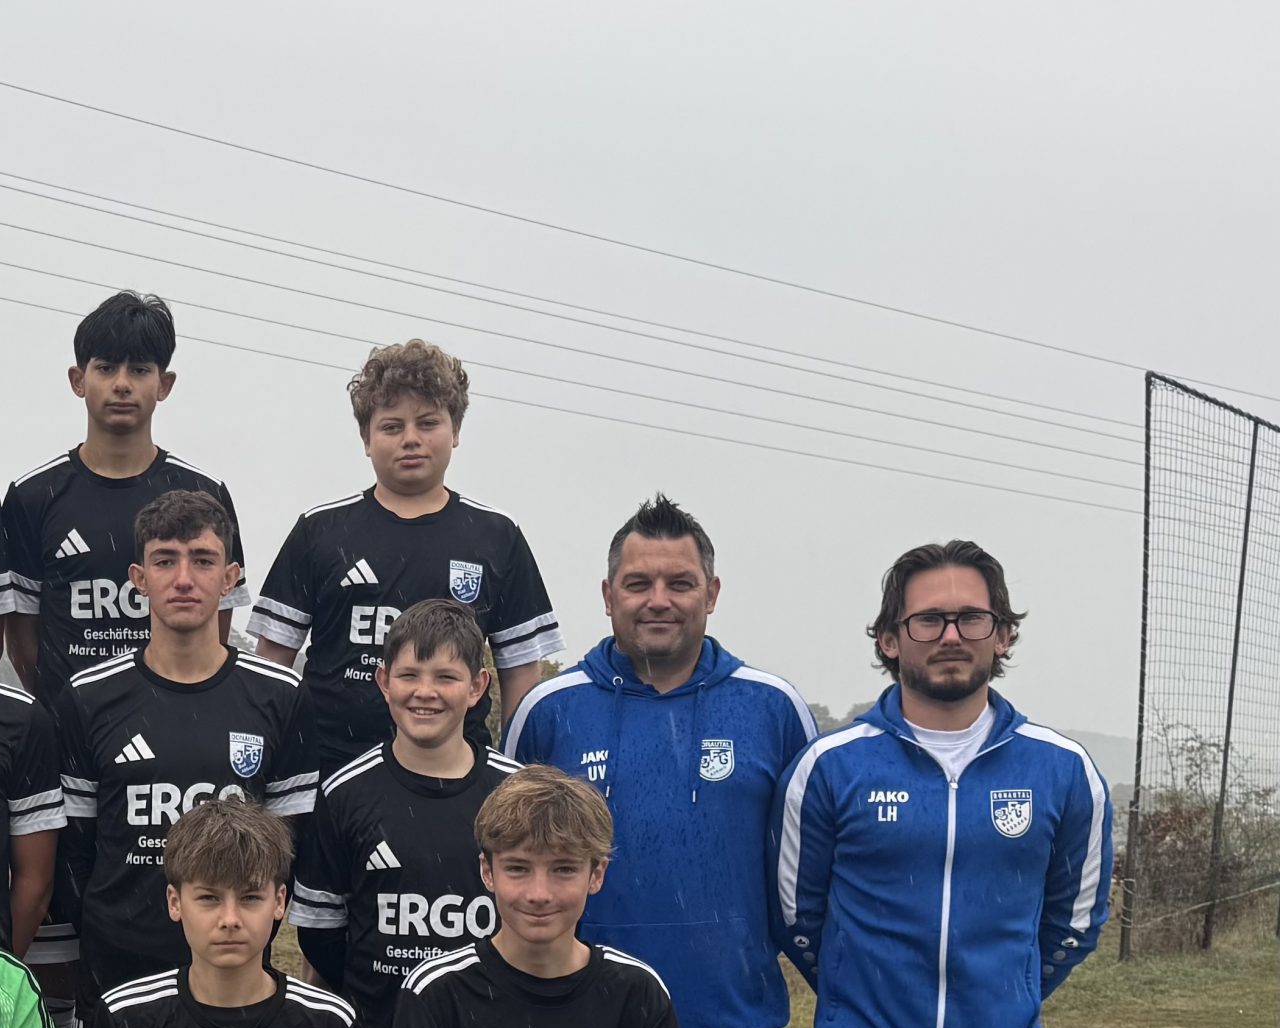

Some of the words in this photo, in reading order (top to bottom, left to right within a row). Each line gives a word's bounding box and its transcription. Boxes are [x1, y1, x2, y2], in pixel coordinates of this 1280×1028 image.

[70, 579, 150, 619] ERG
[350, 605, 402, 645] ER
[83, 628, 151, 640] Geschäftsst
[68, 644, 96, 656] Marc
[100, 647, 109, 656] u.
[344, 667, 372, 681] Marc
[580, 750, 609, 765] JAK
[587, 764, 607, 781] UV
[867, 791, 910, 803] JAKO
[877, 806, 898, 822] LH
[377, 893, 496, 939] ERGO
[372, 960, 399, 975] Marc
